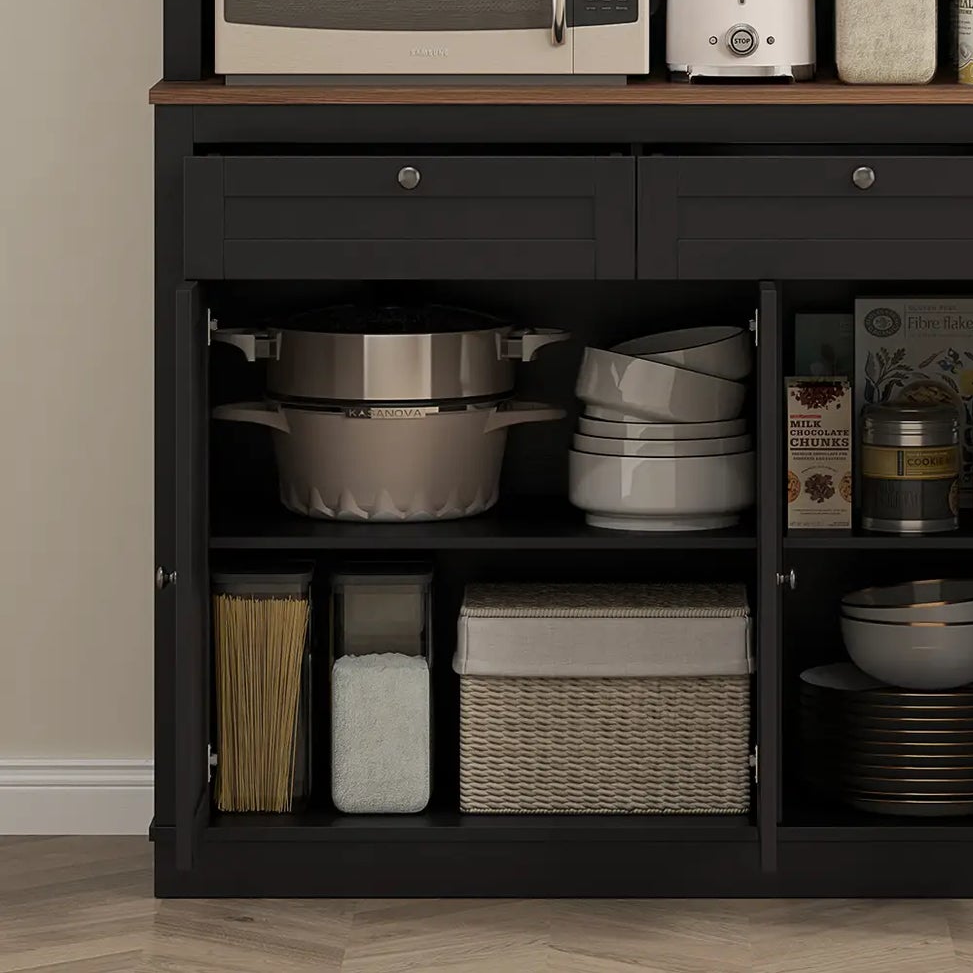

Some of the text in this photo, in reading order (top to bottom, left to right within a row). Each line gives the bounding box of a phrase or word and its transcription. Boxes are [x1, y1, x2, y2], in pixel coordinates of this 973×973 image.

[734, 37, 751, 45] STOP
[908, 314, 940, 330] Fibre
[348, 408, 422, 418] KASANOVA
[790, 420, 822, 428] MILK
[790, 437, 849, 447] CHUNKS
[907, 458, 944, 467] COOKIE
